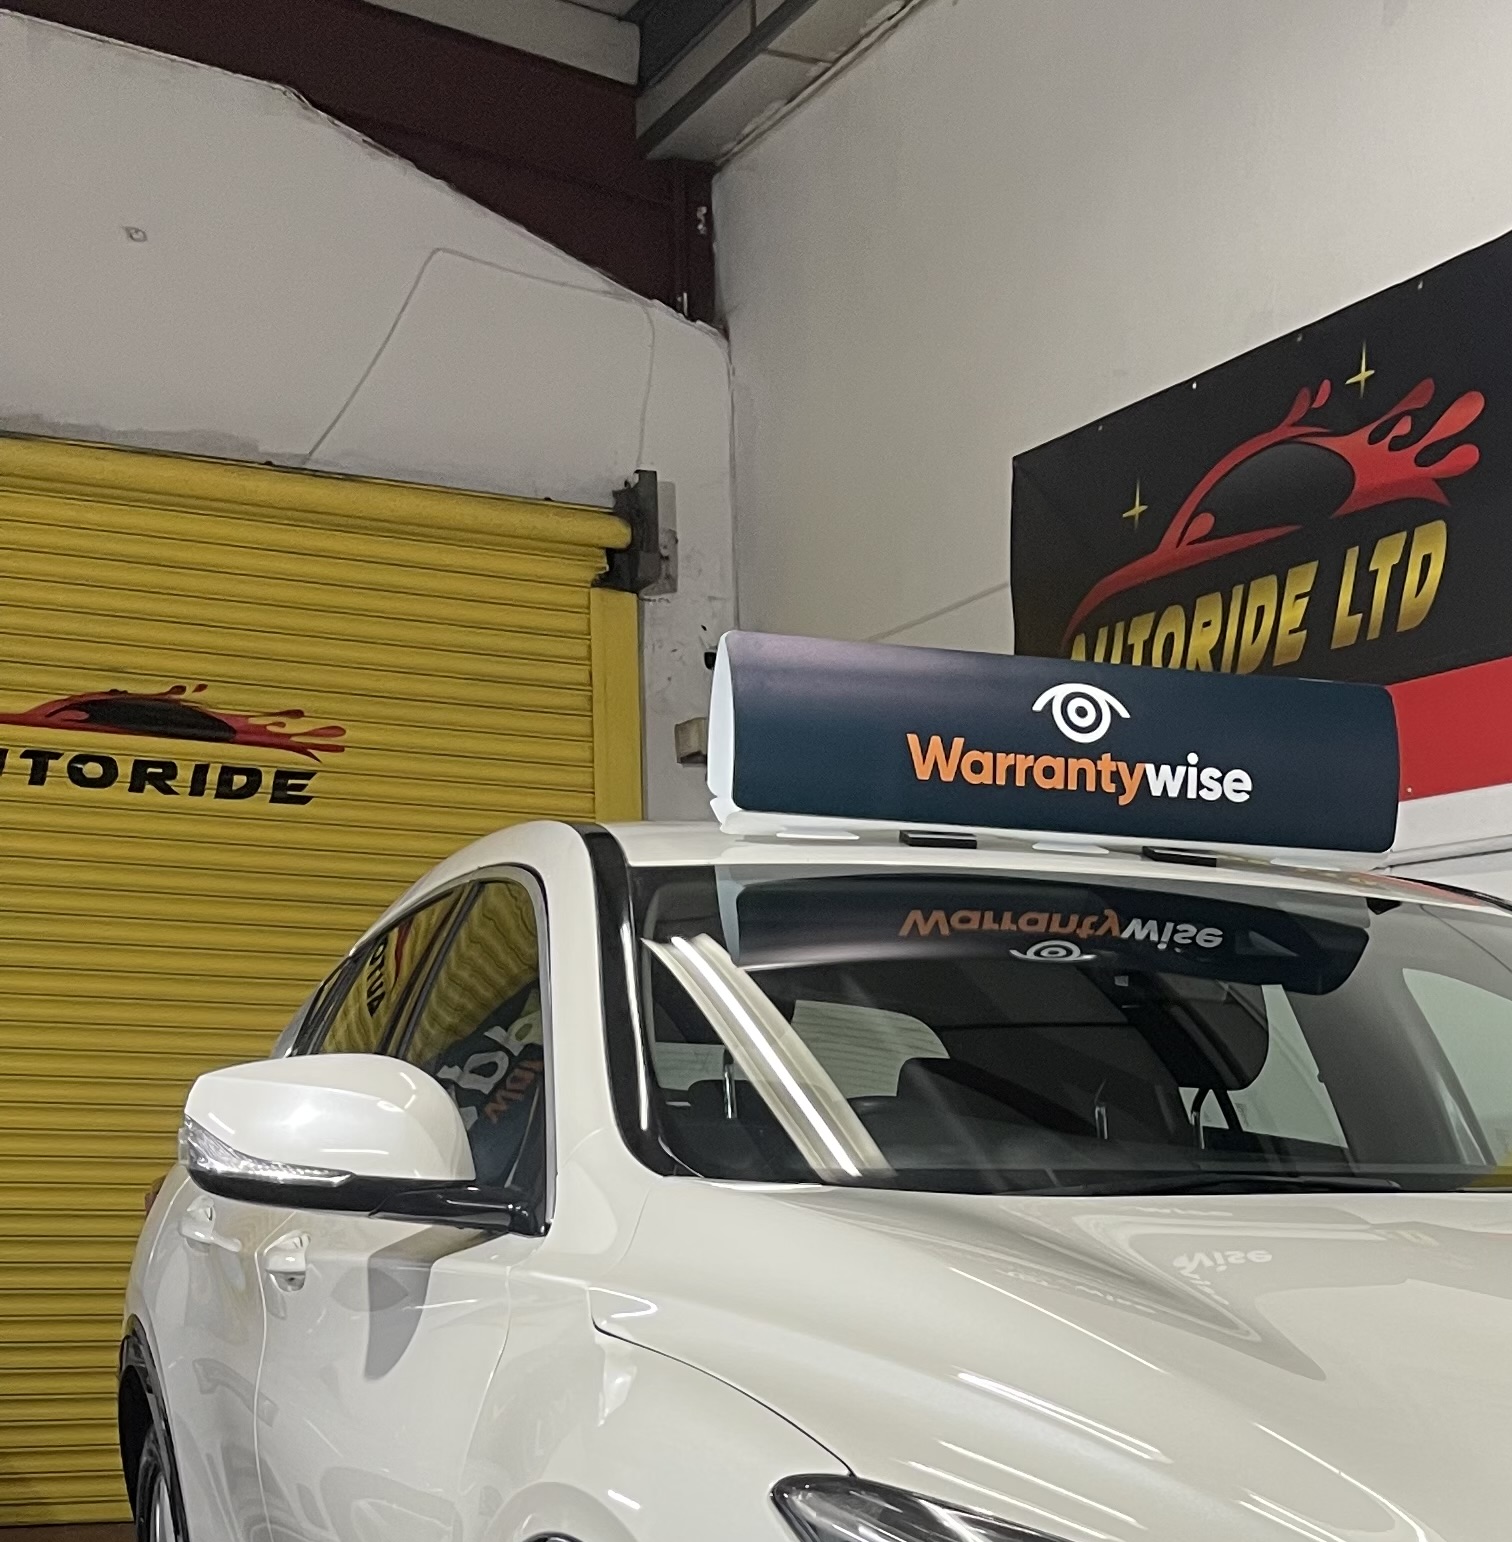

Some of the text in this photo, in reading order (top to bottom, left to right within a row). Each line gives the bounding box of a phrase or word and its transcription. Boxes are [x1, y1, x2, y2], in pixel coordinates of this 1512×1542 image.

[1331, 519, 1447, 650] LTD
[0, 748, 318, 805] TORIDE
[906, 733, 1253, 805] Warrantywise
